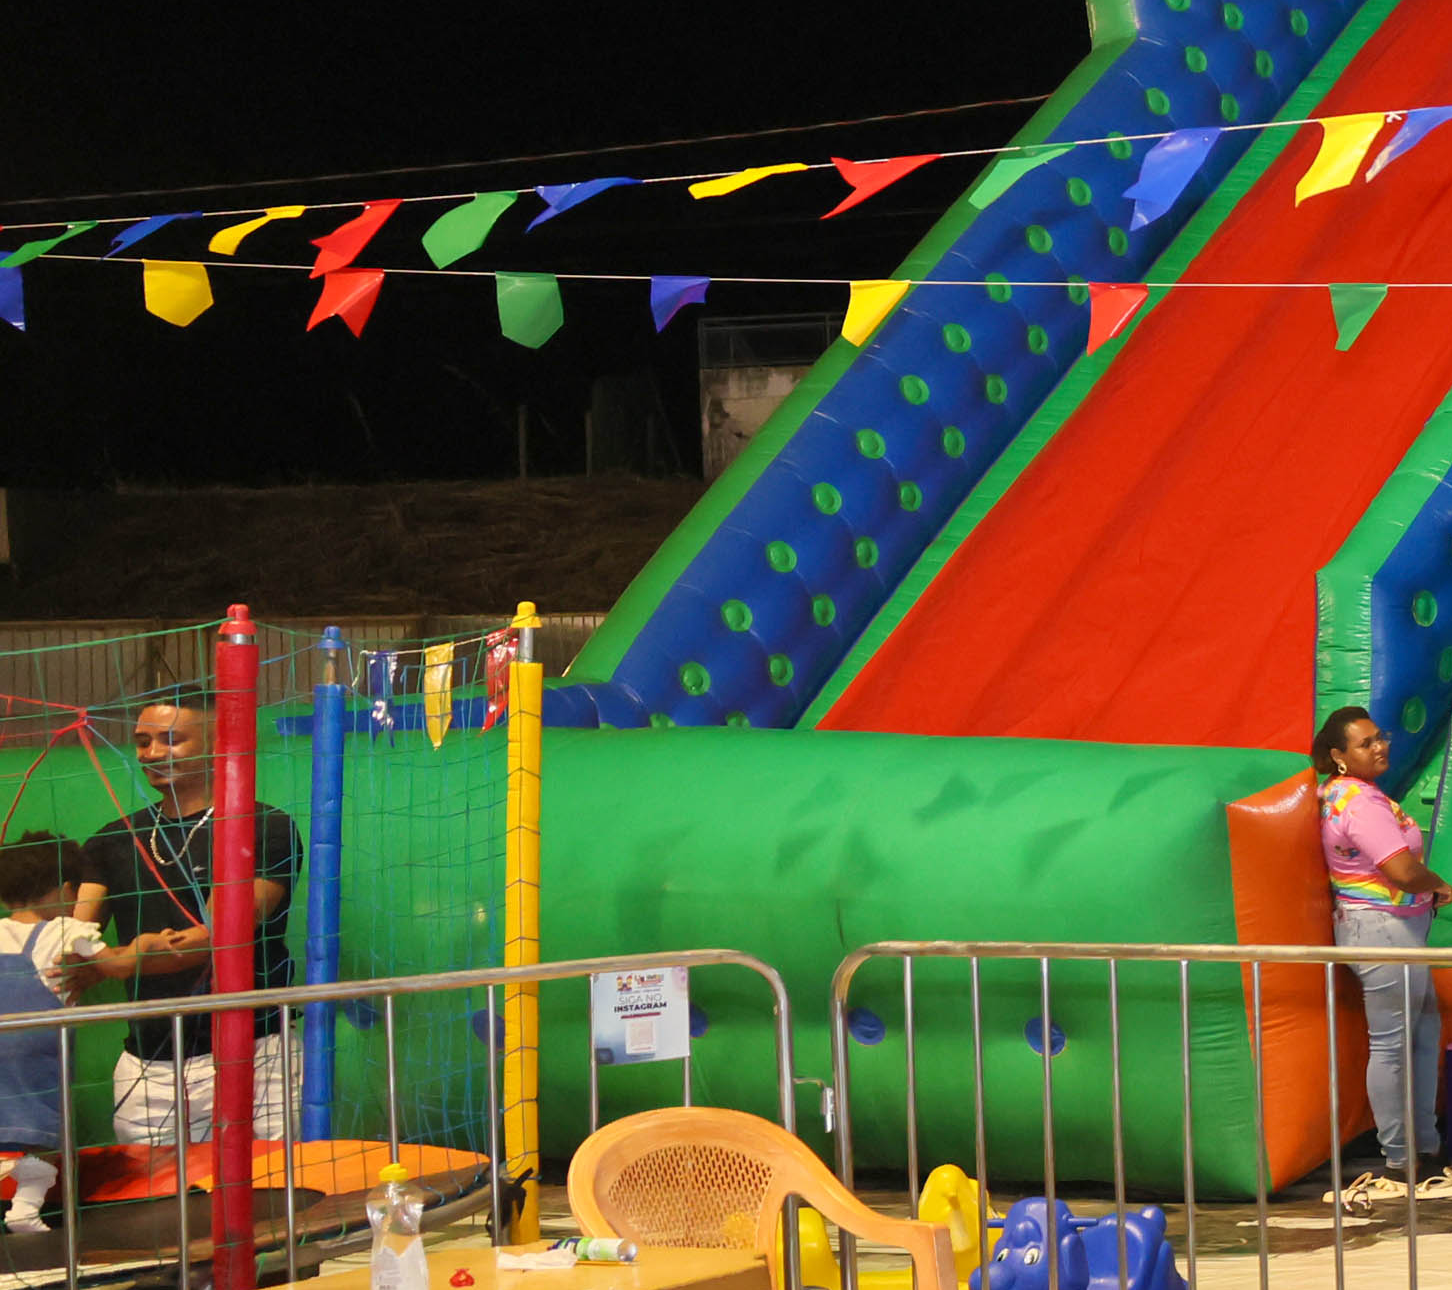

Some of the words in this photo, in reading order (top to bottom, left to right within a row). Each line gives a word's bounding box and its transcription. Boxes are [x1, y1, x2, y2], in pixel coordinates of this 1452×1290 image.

[618, 995, 643, 1005] SIGA
[645, 993, 663, 1003] NO
[613, 1001, 668, 1013] INSTAGRAM
